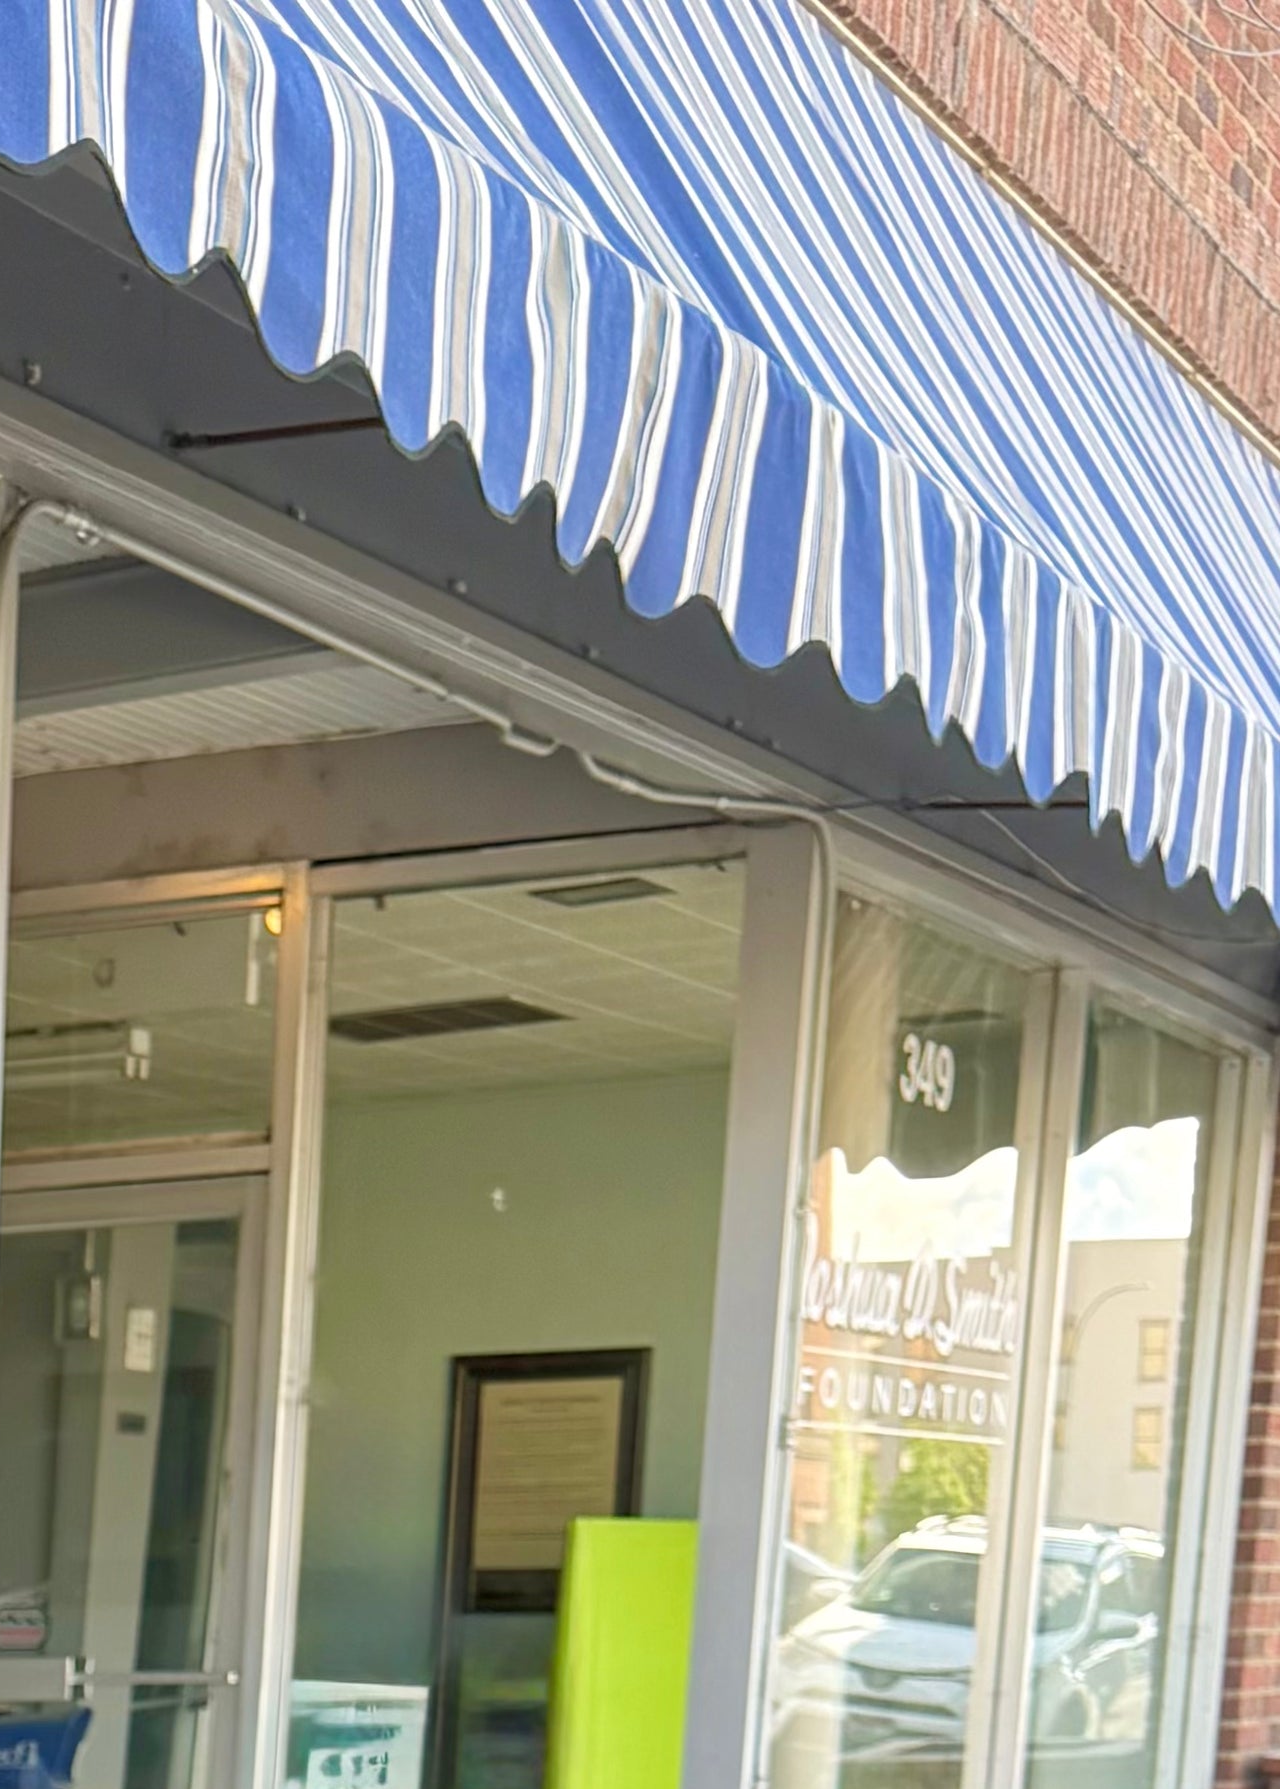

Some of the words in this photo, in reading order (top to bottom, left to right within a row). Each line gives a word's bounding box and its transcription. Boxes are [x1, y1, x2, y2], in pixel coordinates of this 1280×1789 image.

[899, 1033, 955, 1112] 349
[934, 1256, 1018, 1357] Smith
[796, 1366, 1008, 1427] FOUNDATION
